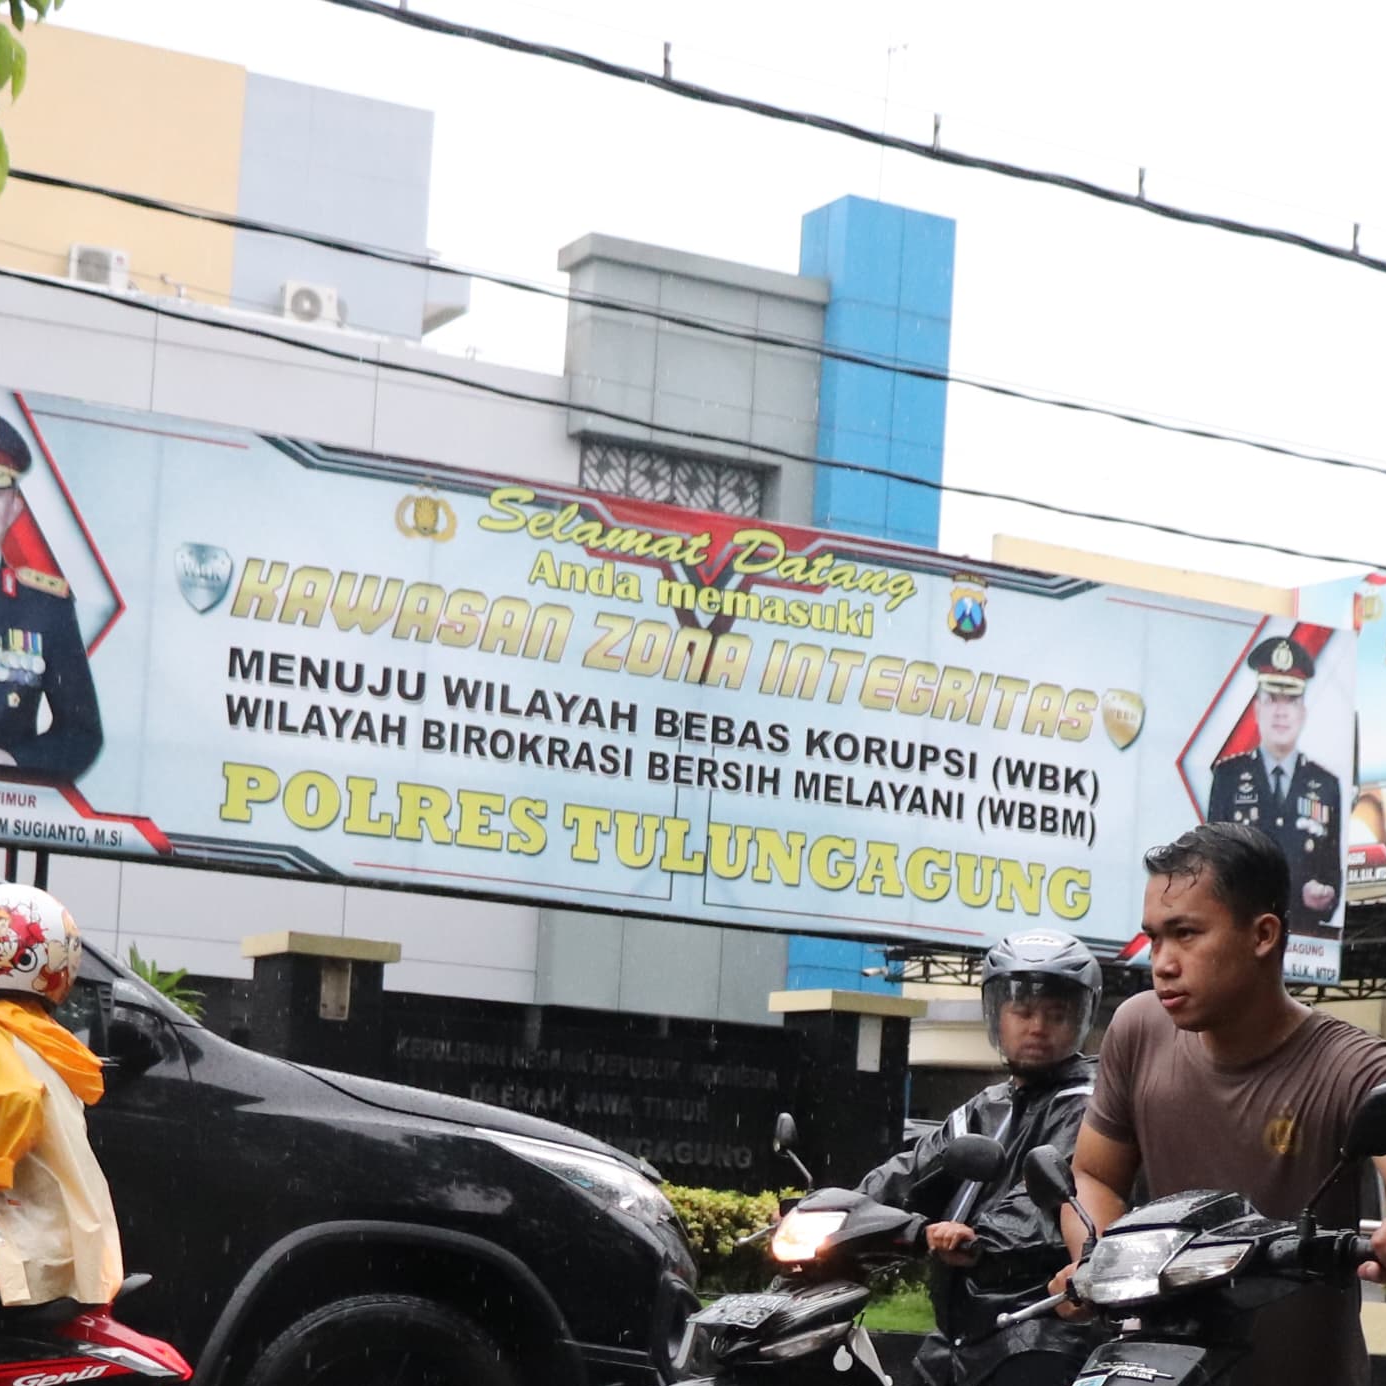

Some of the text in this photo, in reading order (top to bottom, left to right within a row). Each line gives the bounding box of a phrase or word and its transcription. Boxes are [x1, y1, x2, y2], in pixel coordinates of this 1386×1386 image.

[478, 487, 918, 612] Selamat Datang
[527, 550, 874, 638] Anda memasuki
[227, 646, 1100, 805] MENUJU WILAYAH BEBAS KORUPSI (WBK)
[230, 557, 1099, 743] KAWASAN ZONA INTEGRITAS
[13, 818, 90, 849] SUGIANTO,
[93, 828, 123, 848] M.Si
[219, 760, 1093, 920] POLRES TULUNGAGUNG
[225, 693, 1098, 847] WILAYAH BIROKRASI BERSIH MELAYANI (WBBM)
